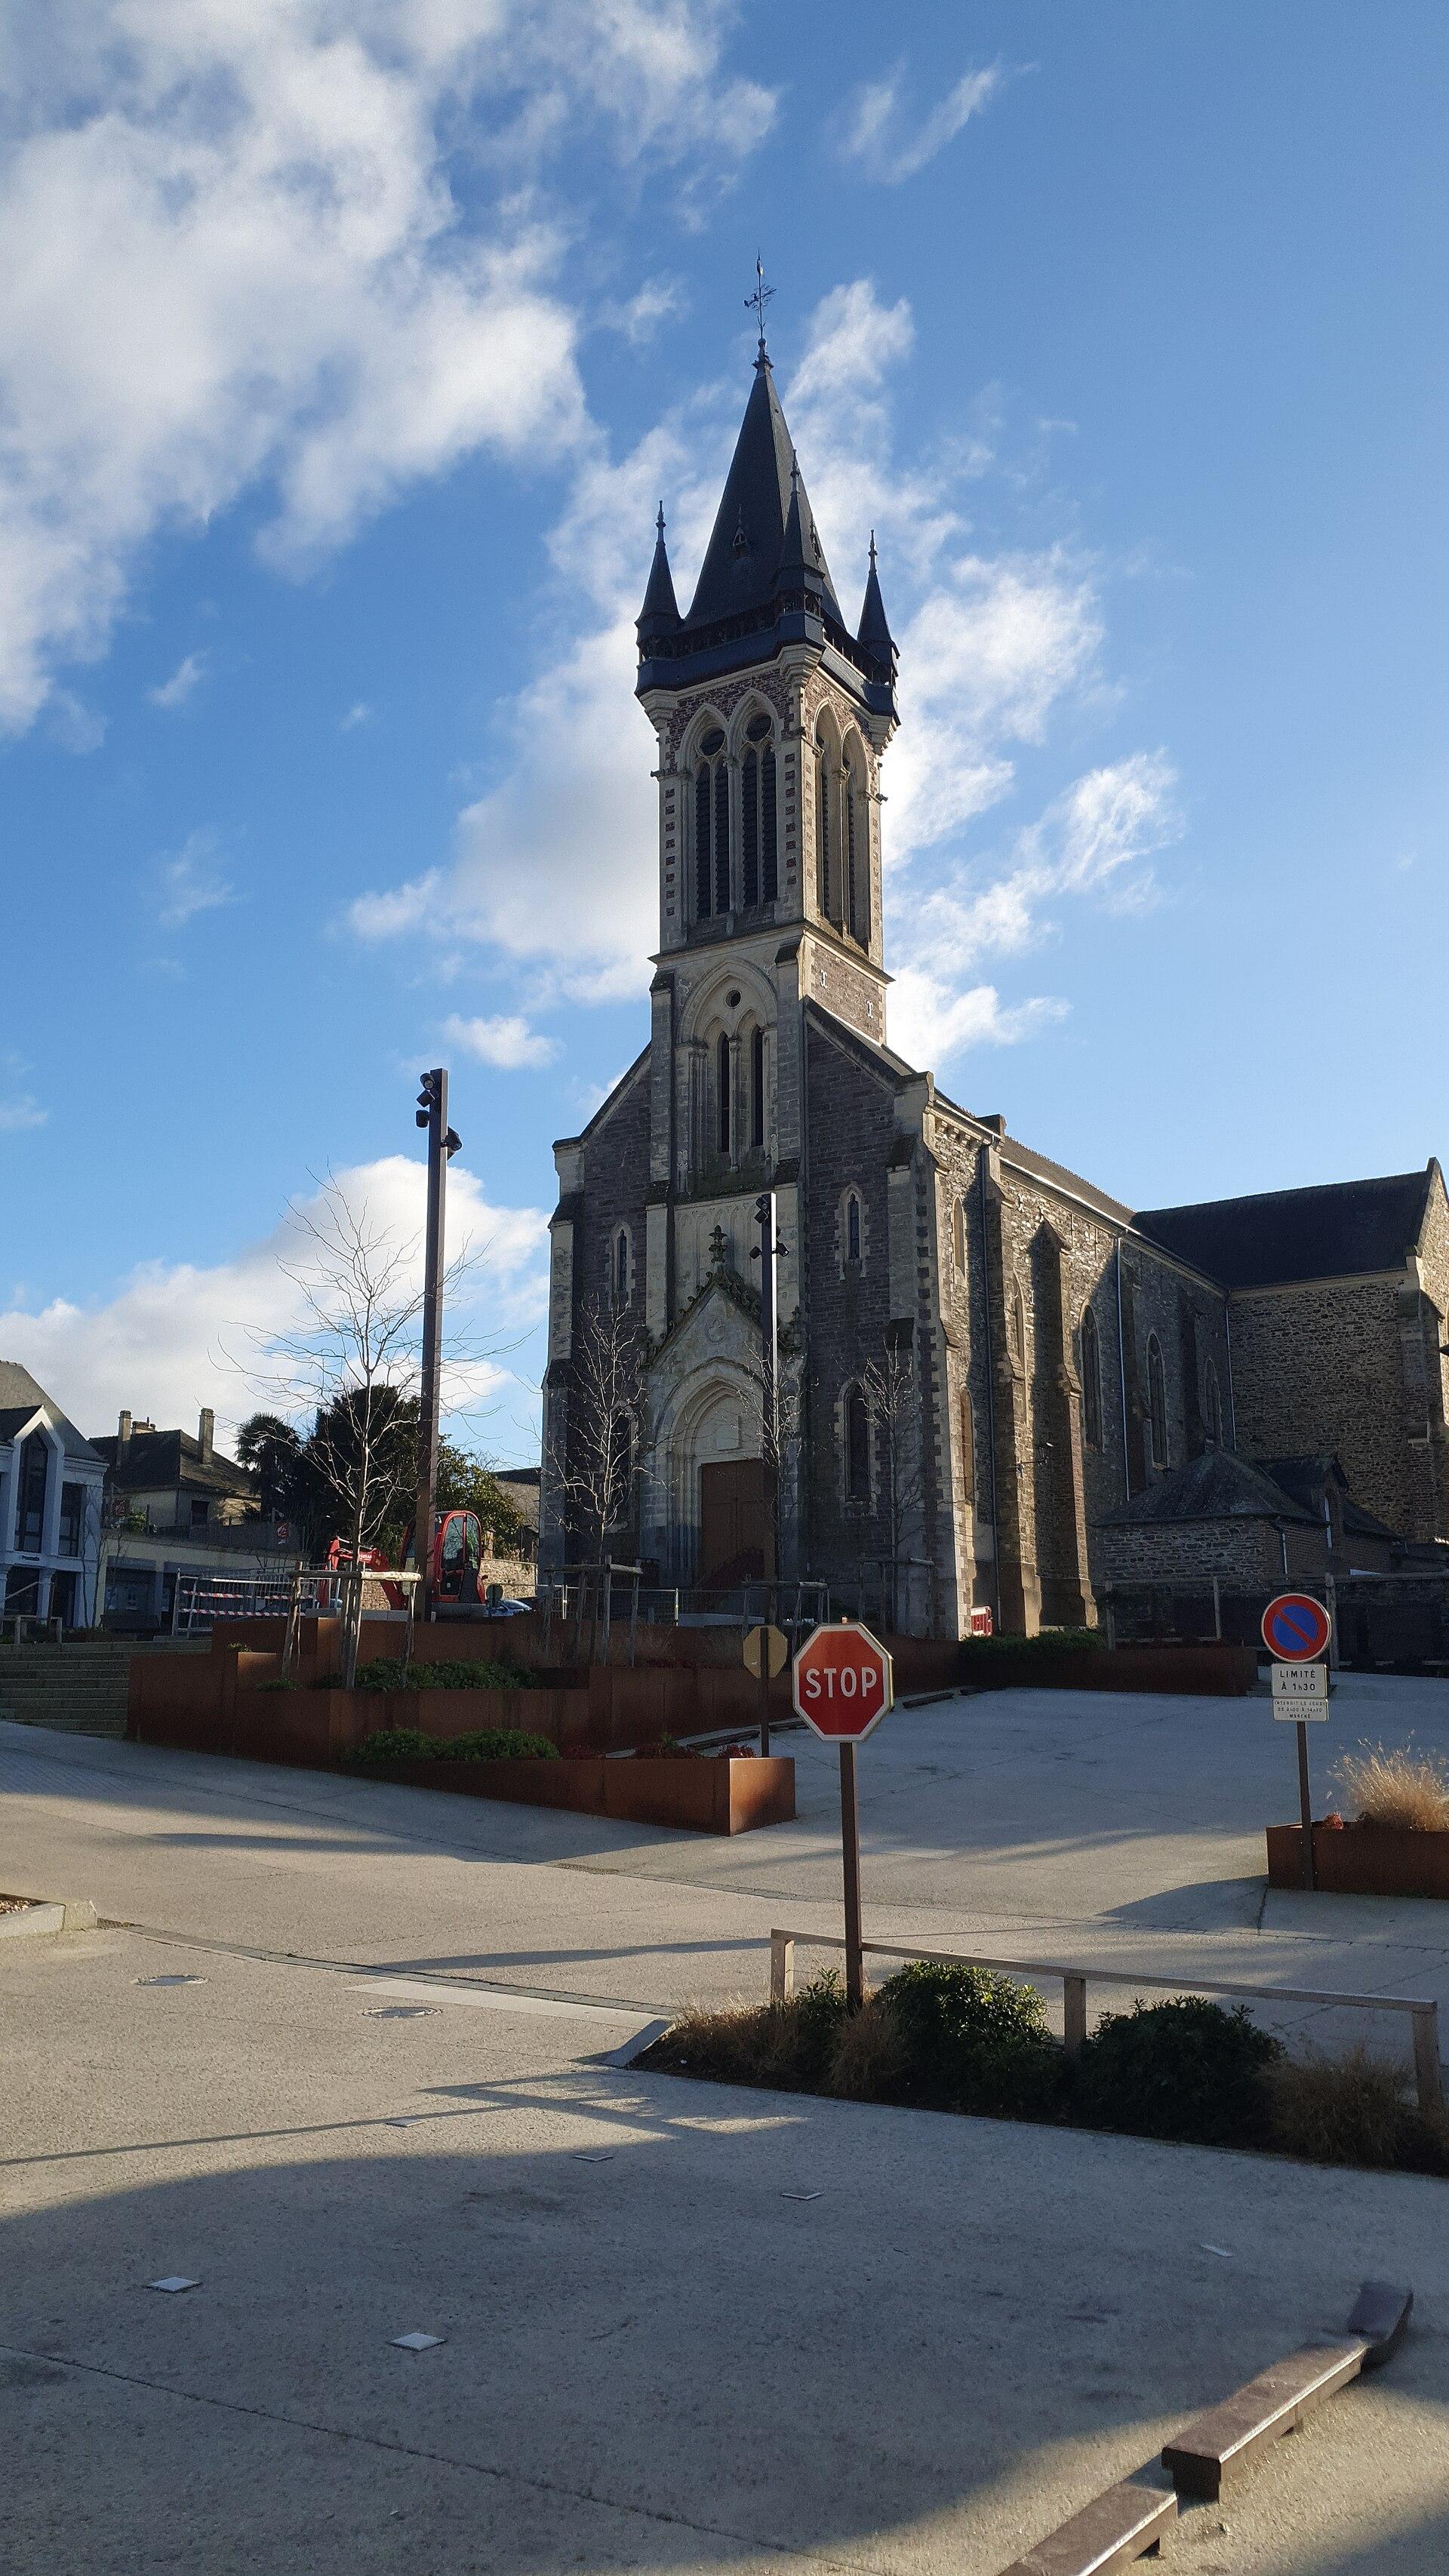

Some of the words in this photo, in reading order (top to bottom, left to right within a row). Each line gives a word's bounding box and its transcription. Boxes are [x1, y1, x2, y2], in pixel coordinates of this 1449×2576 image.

[1280, 1670, 1316, 1679] LIMITÉ
[805, 1667, 877, 1698] STOP
[1281, 1681, 1287, 1691] À
